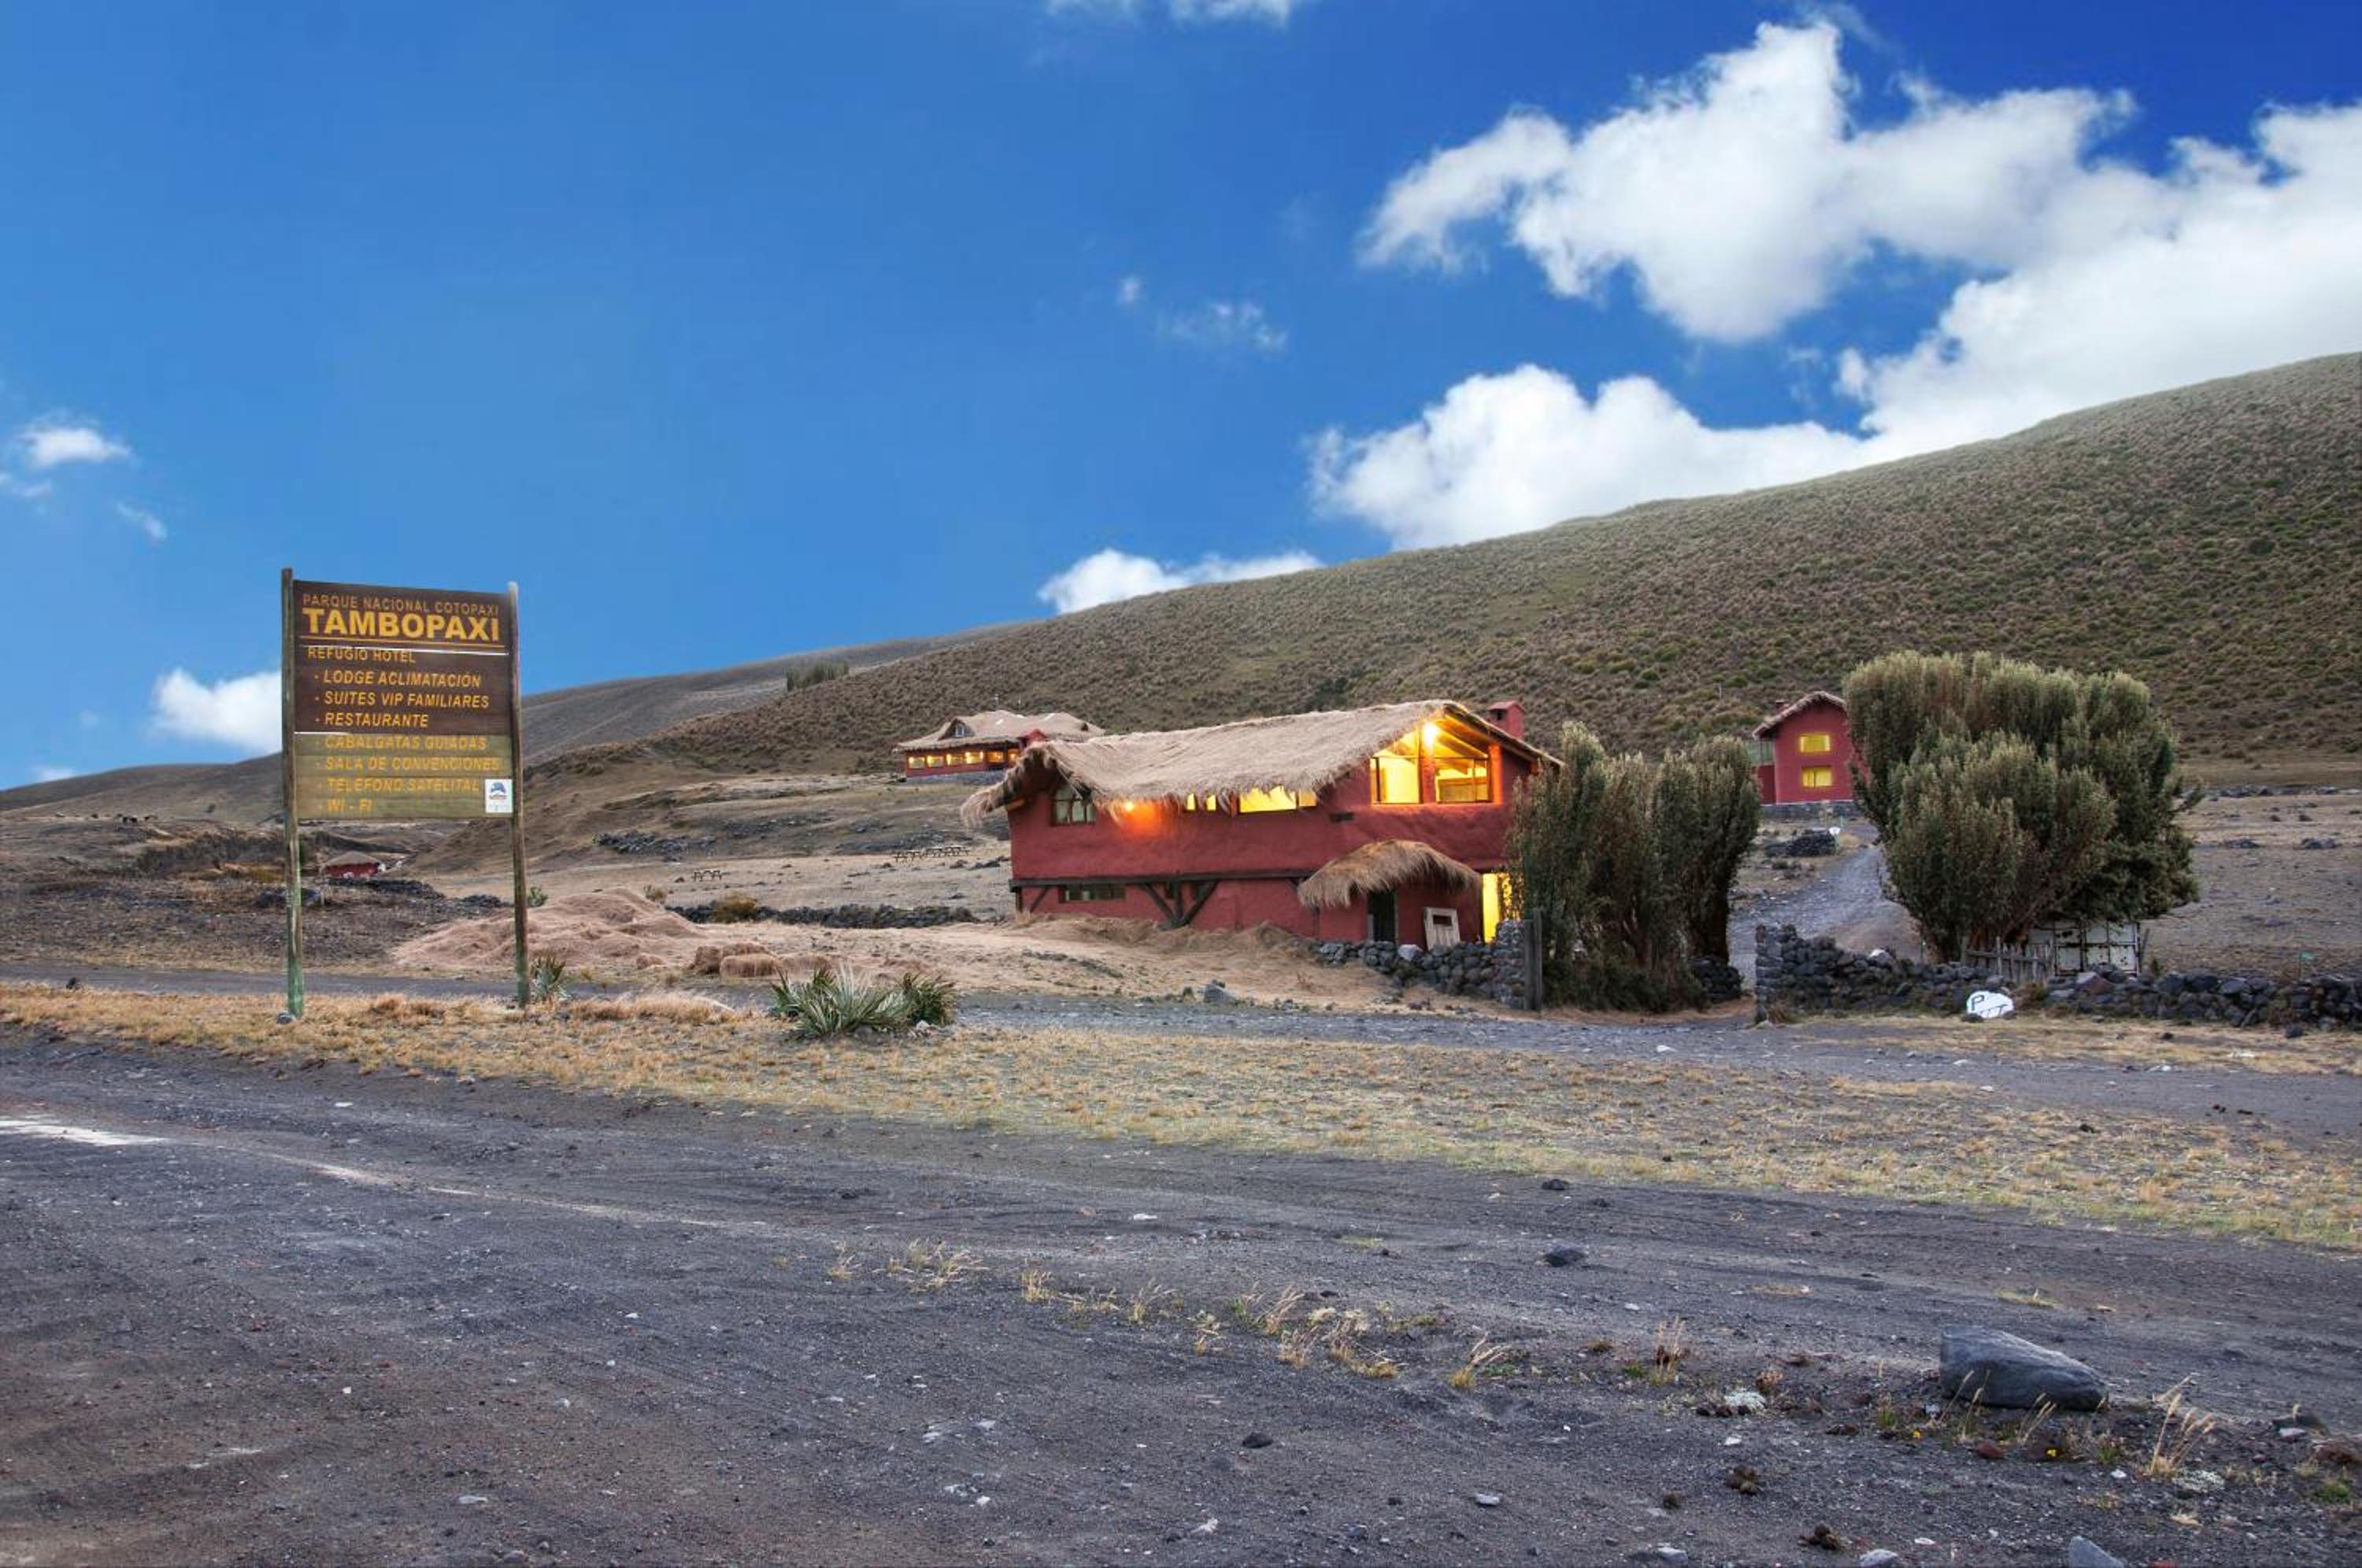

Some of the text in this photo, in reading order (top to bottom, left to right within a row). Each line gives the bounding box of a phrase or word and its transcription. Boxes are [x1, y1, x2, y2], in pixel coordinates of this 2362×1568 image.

[302, 594, 499, 617] PARQUE NACIONAL COTOPAXI
[302, 607, 499, 642] TAMBOPAXI
[308, 647, 416, 664] REFUGIO HOTEL
[324, 670, 374, 685] LODGE
[324, 690, 490, 708] SUITES VIP FAMILIARES
[324, 712, 429, 727] RESTAURANTE
[326, 734, 487, 750] CABALGATAS GUIADAS
[327, 756, 500, 771] SALA DE CONVENCIONES
[406, 778, 479, 792] SATELITAL
